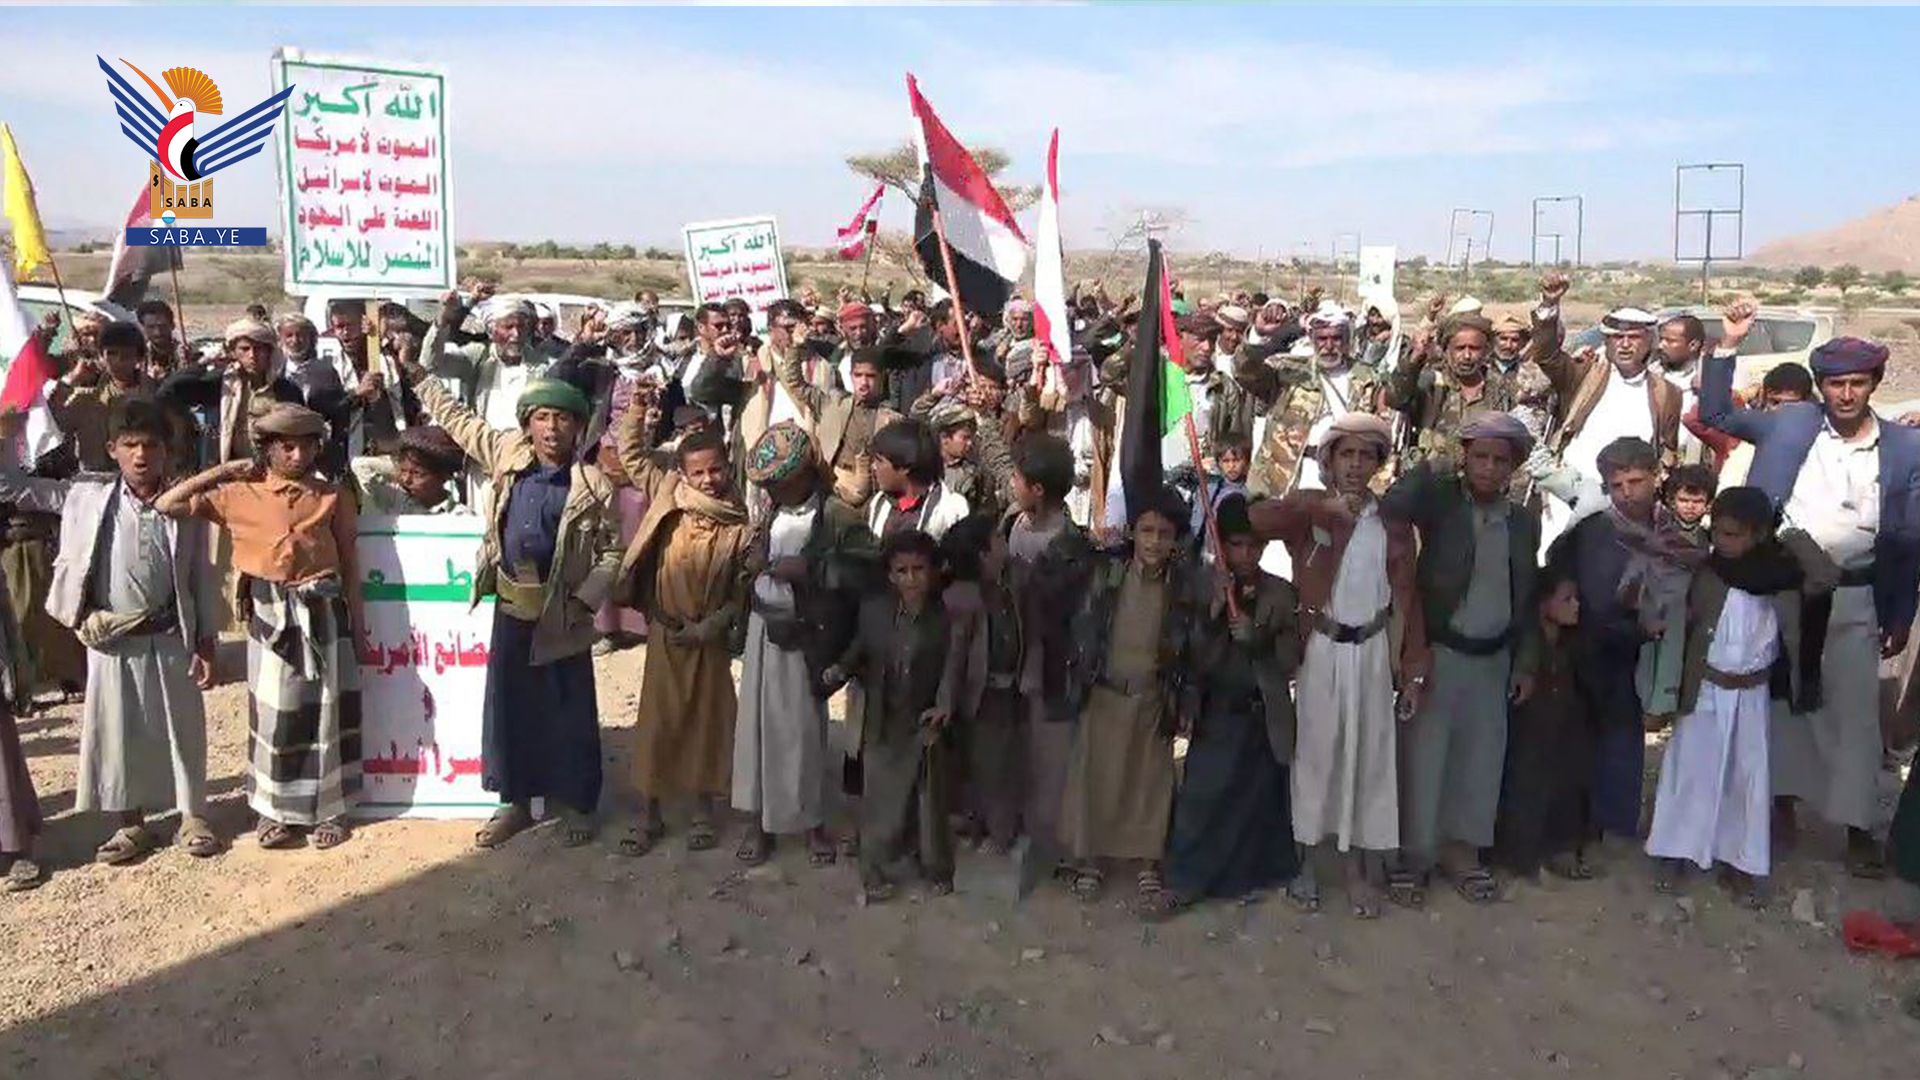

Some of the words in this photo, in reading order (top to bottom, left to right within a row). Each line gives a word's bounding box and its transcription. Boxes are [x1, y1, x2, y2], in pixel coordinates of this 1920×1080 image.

[384, 84, 436, 120] الله
[294, 125, 370, 157] لأمريكا
[377, 136, 436, 161] الموت
[378, 173, 437, 198] الموت
[298, 204, 351, 233] اليهود
[358, 205, 386, 233] على
[394, 206, 439, 231] اللعنة
[743, 232, 772, 250] الله
[378, 240, 439, 275] النصر
